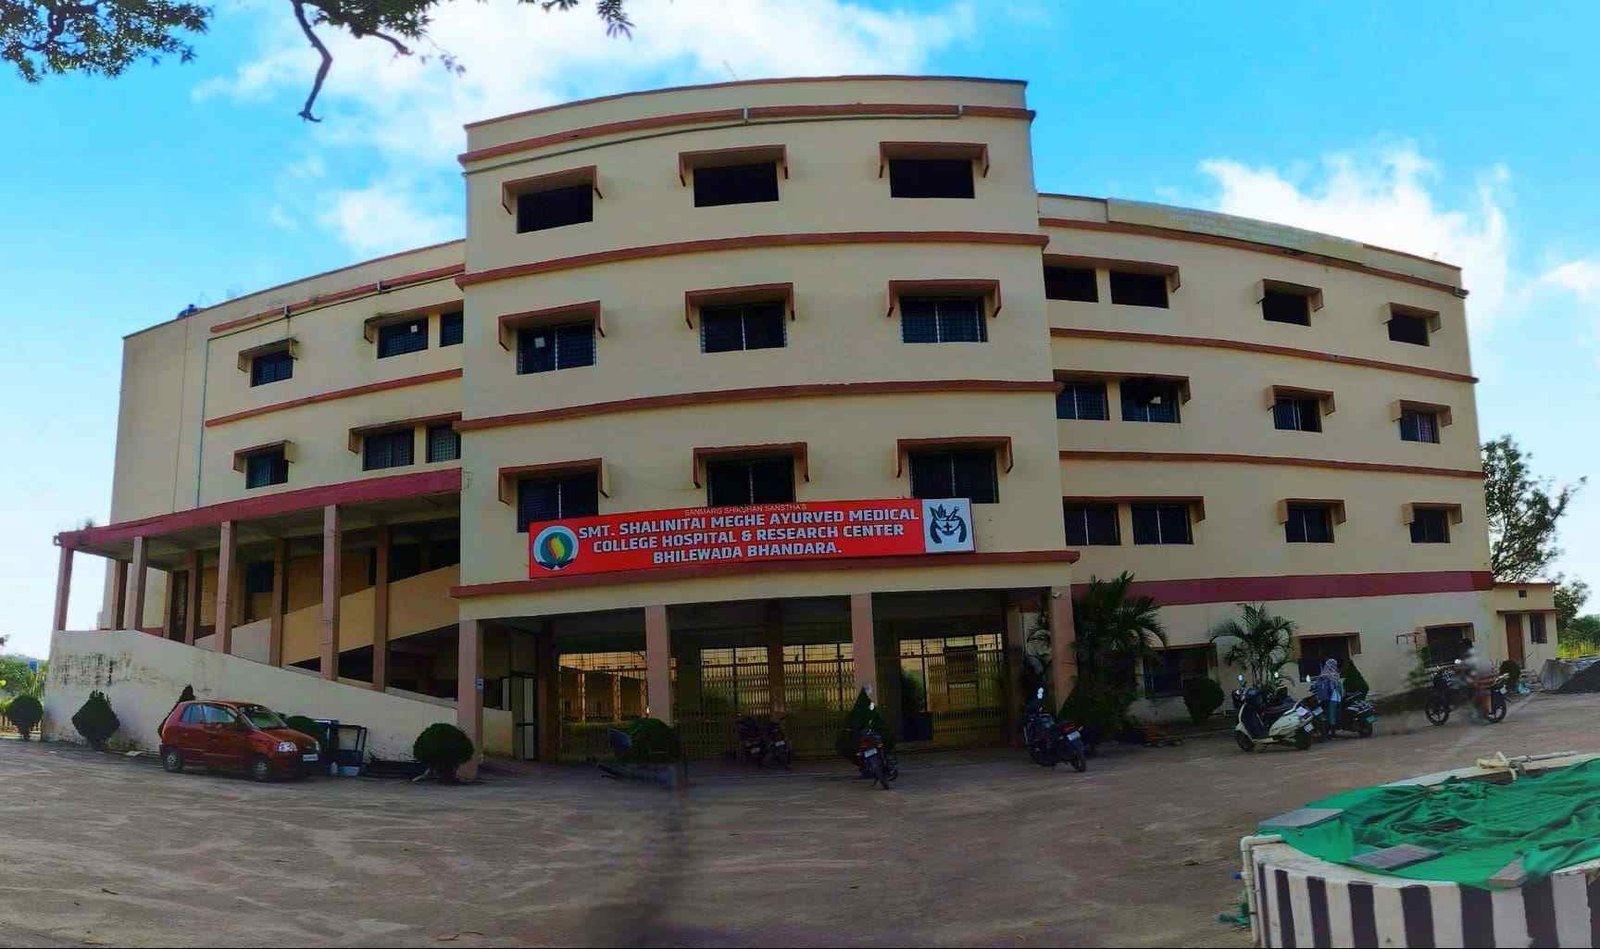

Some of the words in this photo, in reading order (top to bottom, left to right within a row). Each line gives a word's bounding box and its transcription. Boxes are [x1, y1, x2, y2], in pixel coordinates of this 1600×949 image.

[578, 524, 616, 540] SMT.
[619, 517, 706, 535] SHALINITAI
[711, 513, 765, 528] MEGHE
[770, 510, 844, 525] AYURVED
[849, 508, 919, 523] MEDICAL
[593, 537, 657, 553] COLLEGE
[662, 531, 737, 547] HOSPITAL
[741, 531, 752, 542] &
[757, 526, 839, 541] RESEARCH
[843, 524, 904, 538] CENTER
[653, 547, 743, 564] BHILEWADA
[747, 543, 842, 558] BHANDARA.
